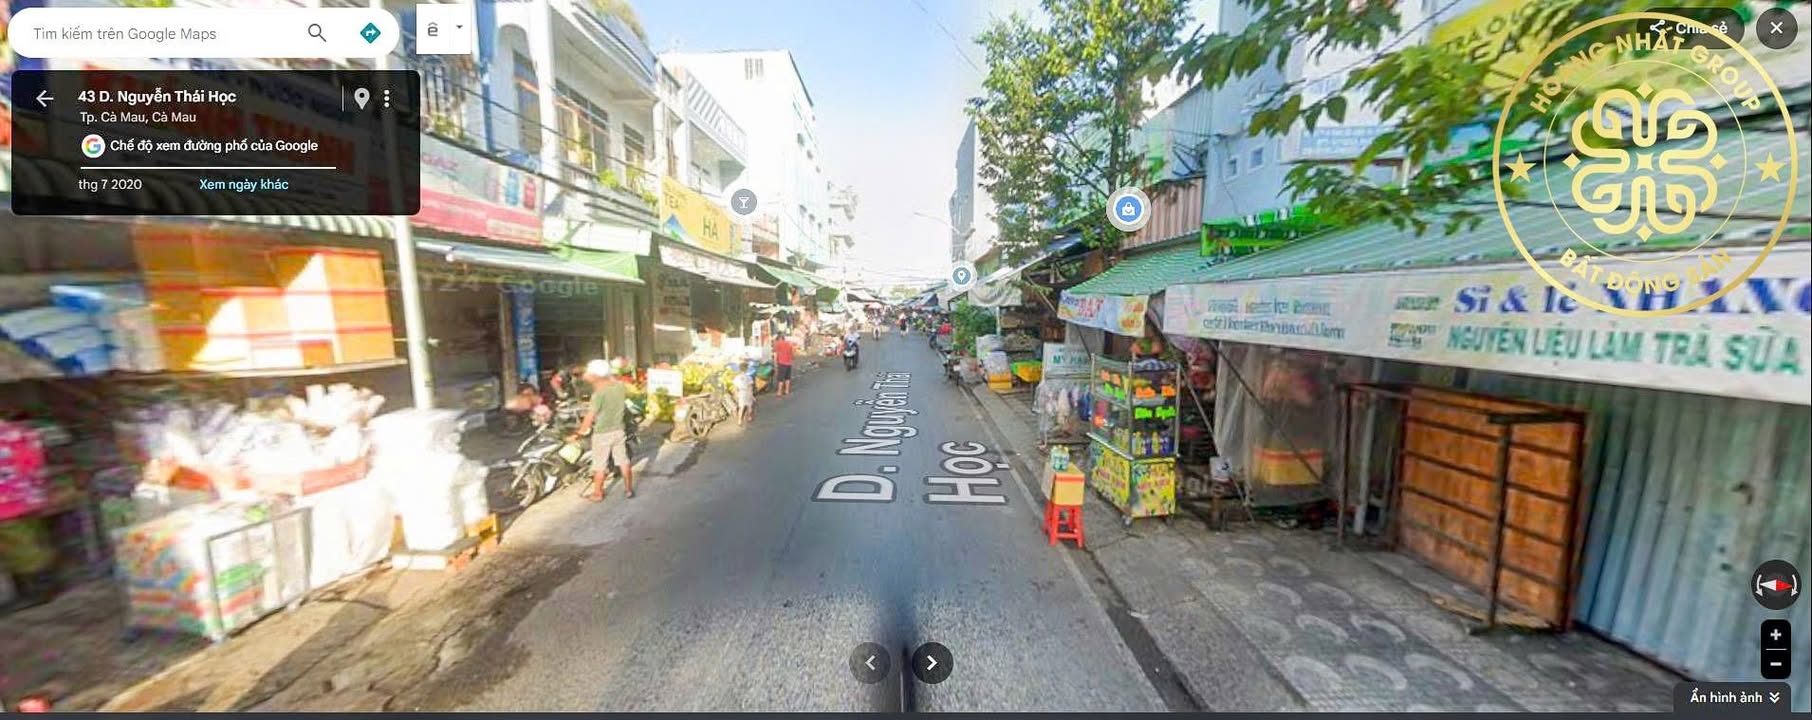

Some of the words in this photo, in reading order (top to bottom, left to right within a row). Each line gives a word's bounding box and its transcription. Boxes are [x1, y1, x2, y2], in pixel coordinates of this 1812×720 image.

[1500, 284, 1529, 313] &
[1447, 321, 1527, 354] NGUYÊN
[1724, 325, 1807, 375] SỮA
